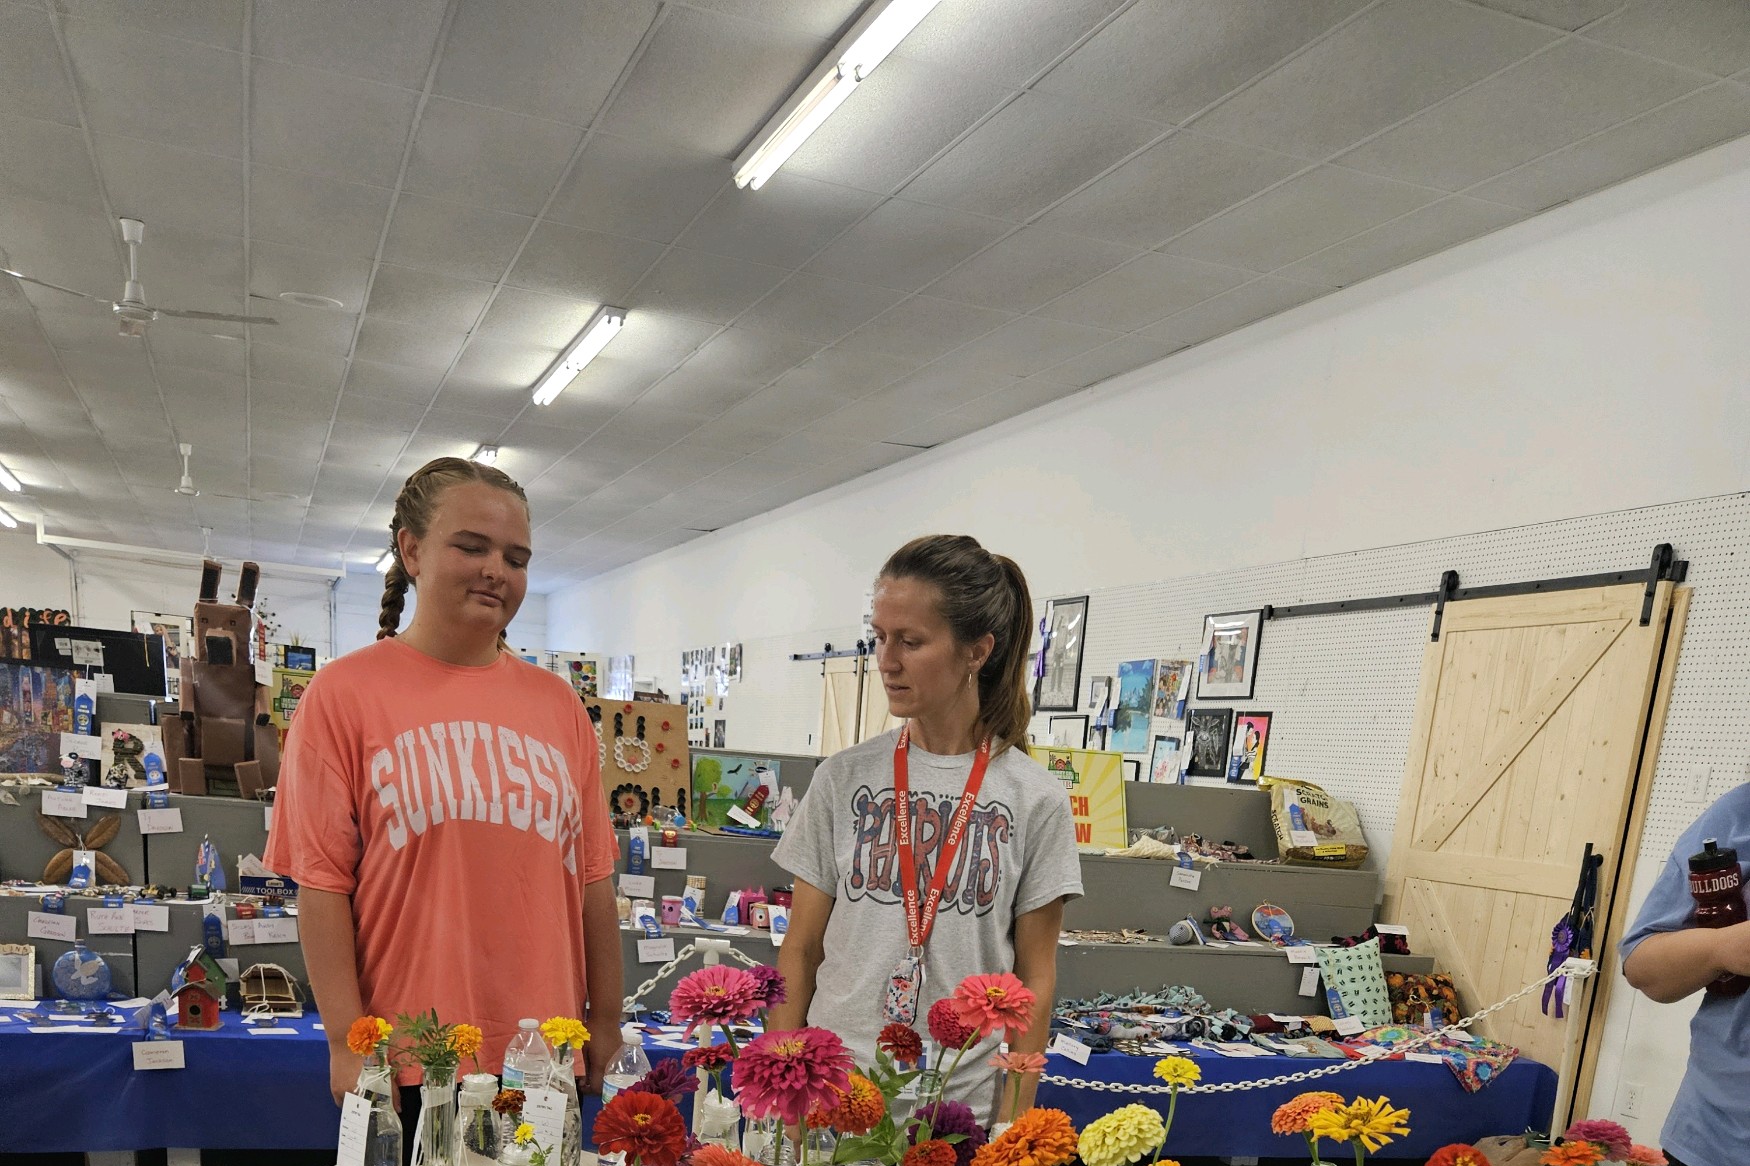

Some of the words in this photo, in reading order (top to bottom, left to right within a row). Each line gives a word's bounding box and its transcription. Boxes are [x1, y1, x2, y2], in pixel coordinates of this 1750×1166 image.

[899, 790, 909, 845] Excellence
[948, 791, 975, 846] Excellence
[1300, 797, 1329, 809] GRAINS
[907, 889, 919, 945] Excellence
